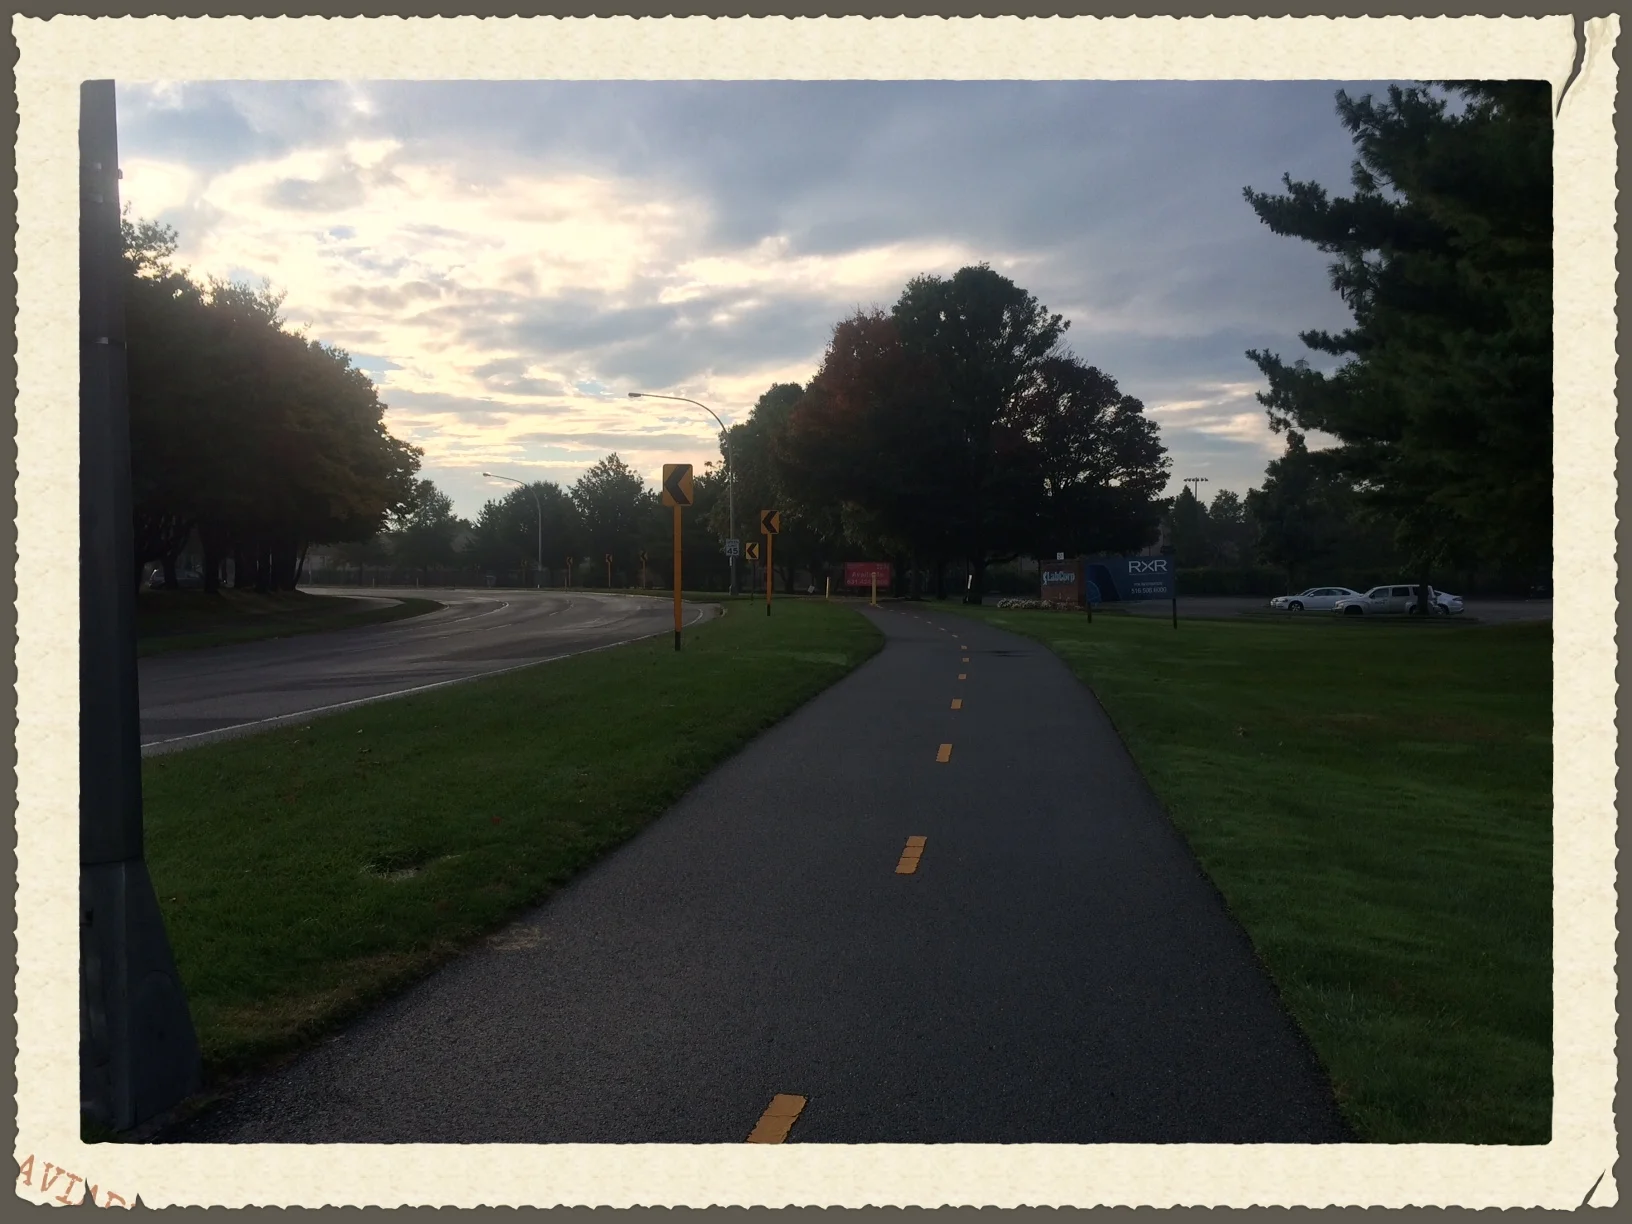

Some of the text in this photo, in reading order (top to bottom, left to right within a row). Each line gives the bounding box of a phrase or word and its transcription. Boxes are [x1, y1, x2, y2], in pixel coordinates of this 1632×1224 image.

[727, 547, 738, 555] 45
[1128, 559, 1168, 573] RXR
[1047, 570, 1075, 583] LabCorp
